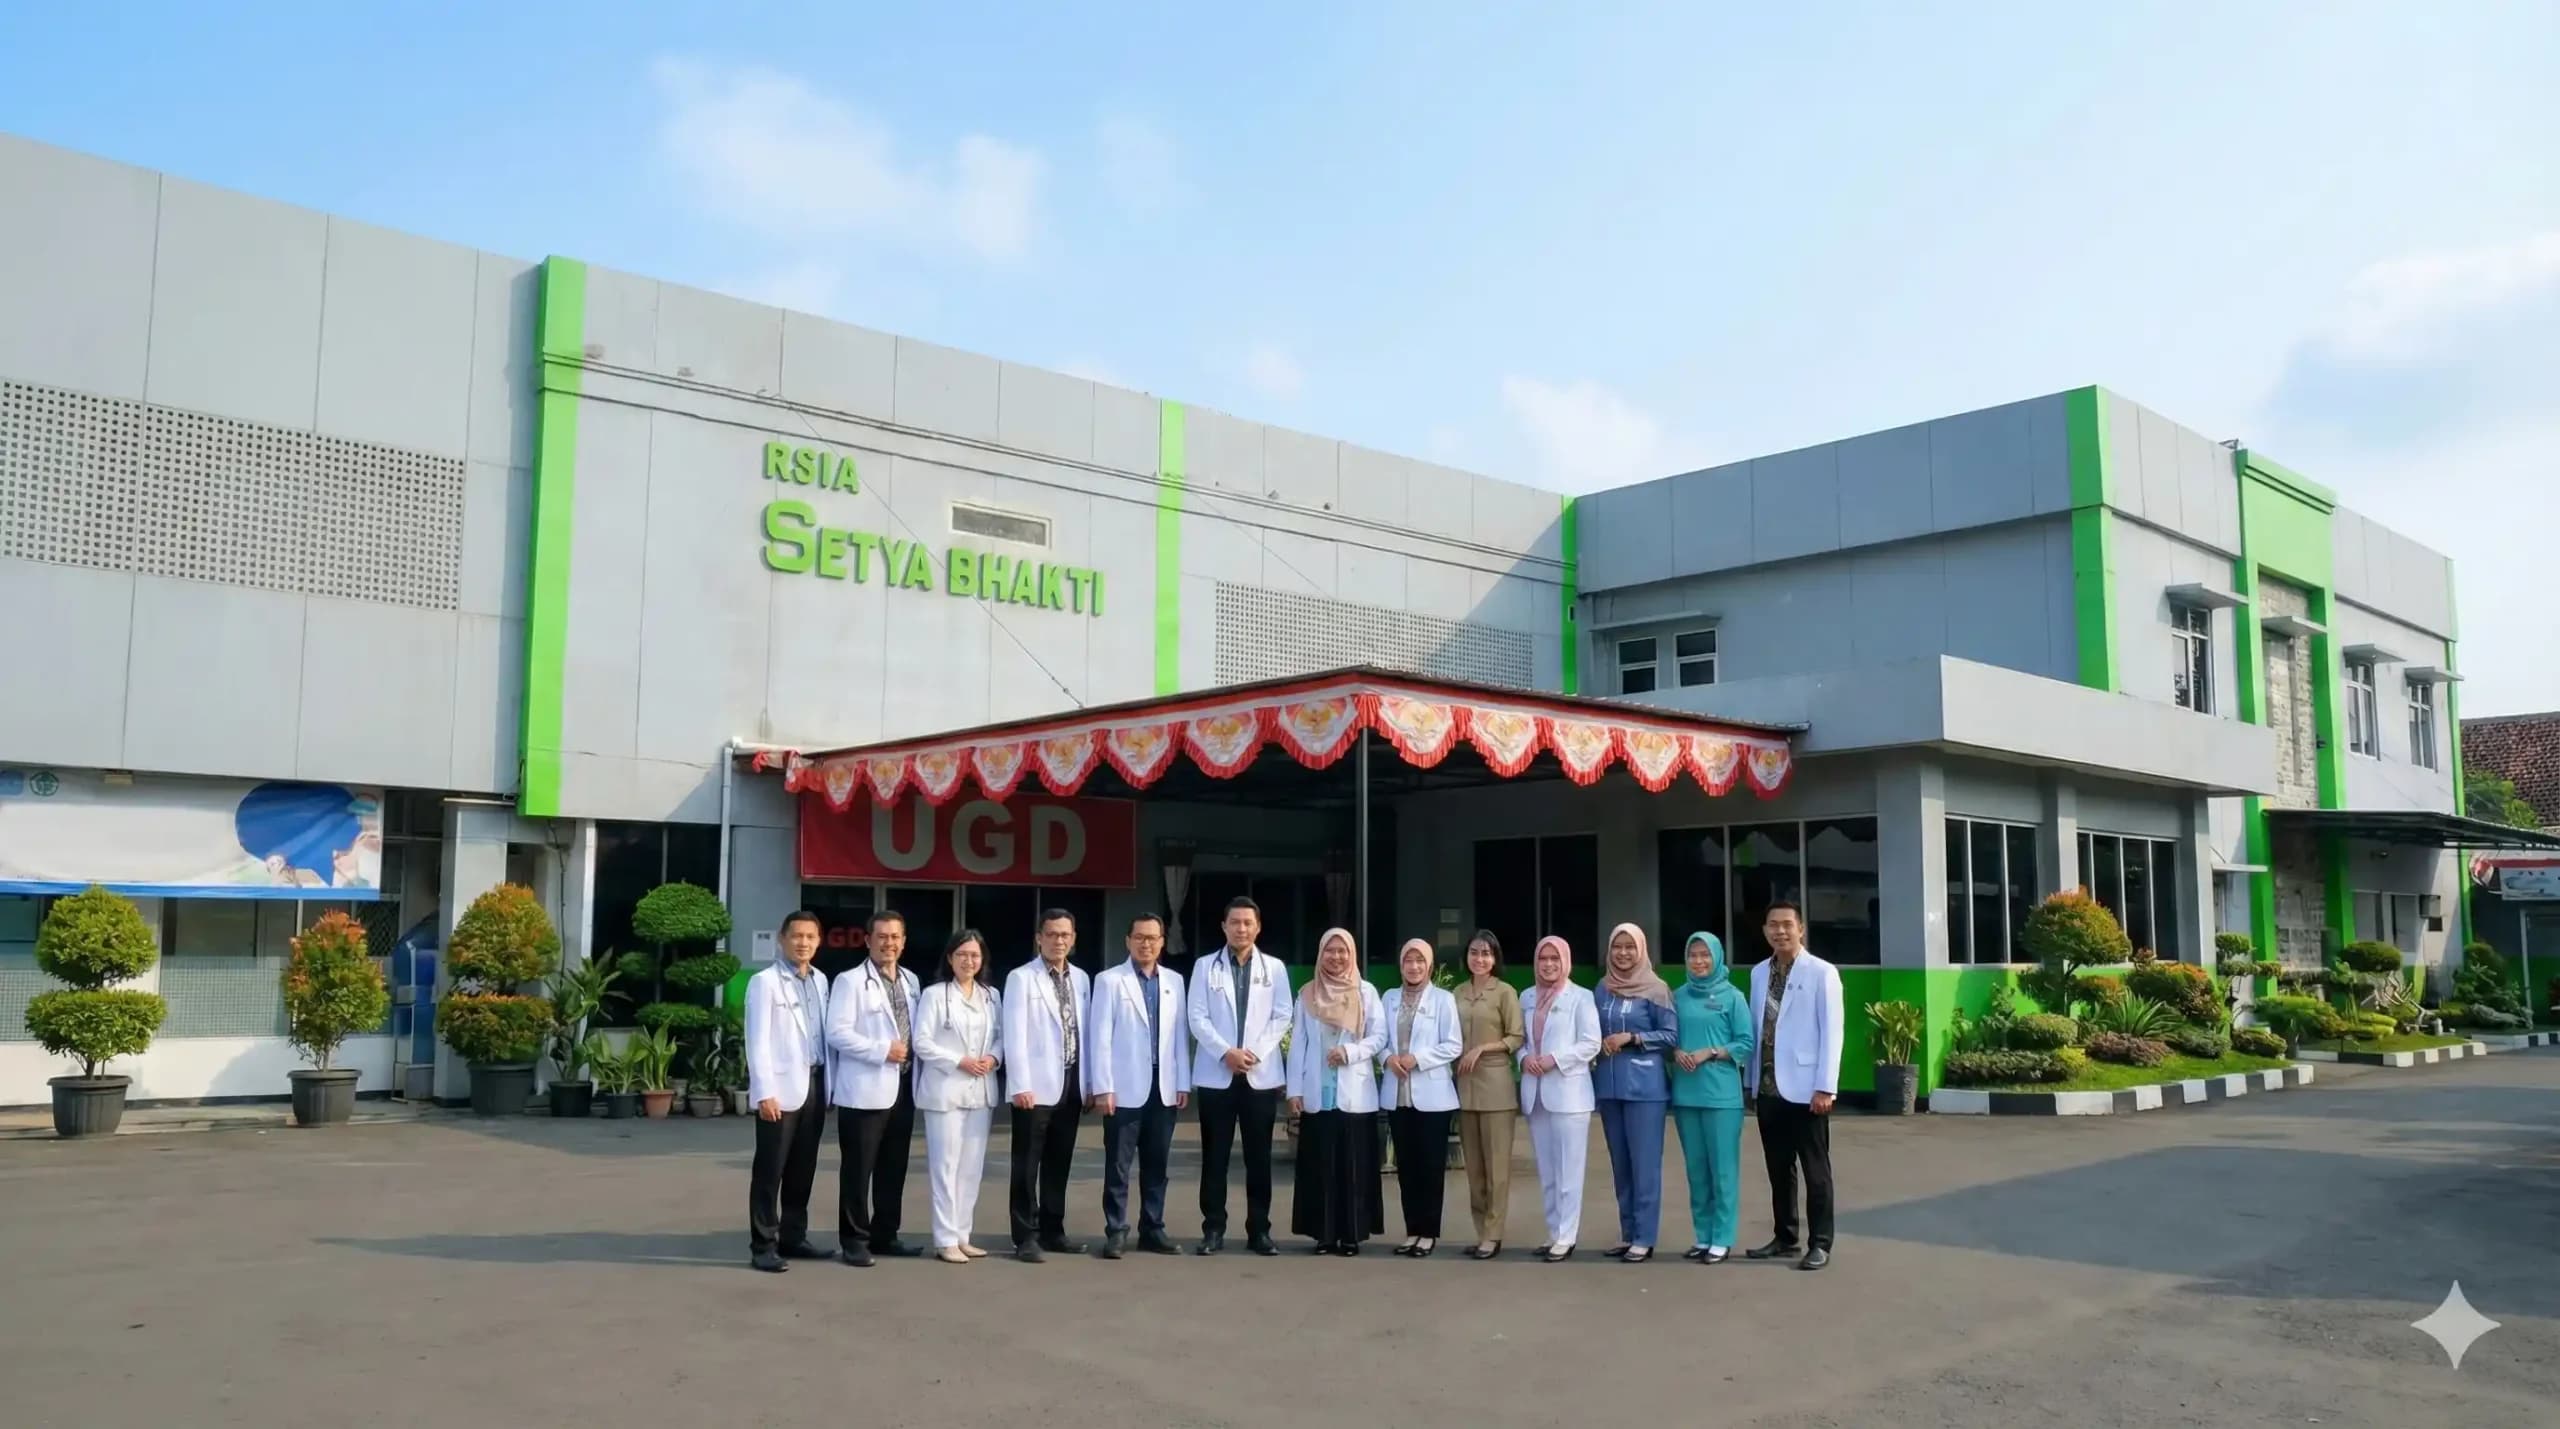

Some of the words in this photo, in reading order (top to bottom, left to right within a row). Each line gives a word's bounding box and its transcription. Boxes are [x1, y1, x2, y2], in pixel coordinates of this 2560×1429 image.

[763, 441, 860, 495] RSIA
[761, 499, 933, 591] SETYA
[946, 547, 1105, 617] BHAKTI
[872, 795, 1086, 876] UGD
[821, 926, 865, 948] GD
